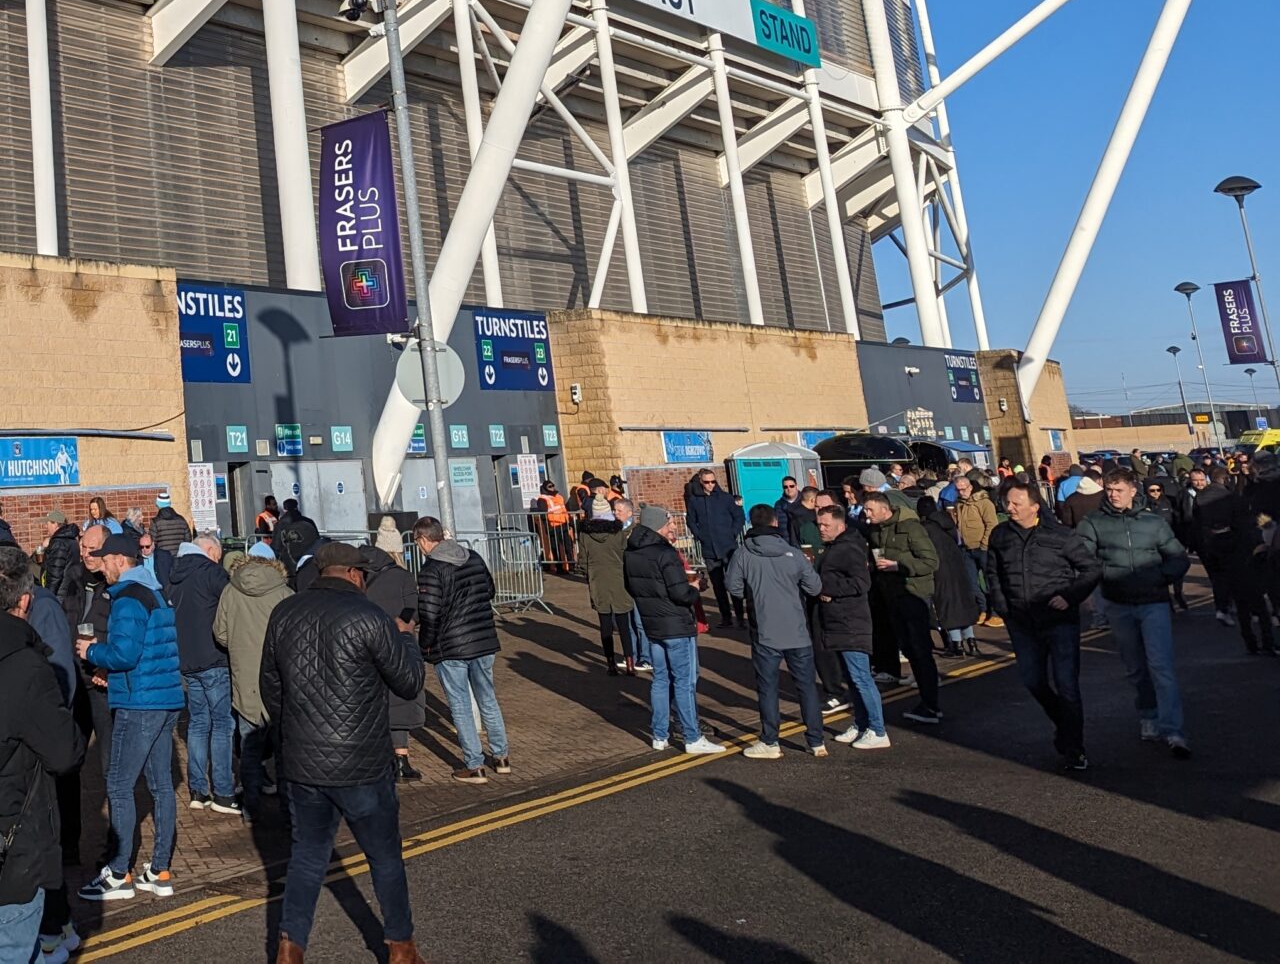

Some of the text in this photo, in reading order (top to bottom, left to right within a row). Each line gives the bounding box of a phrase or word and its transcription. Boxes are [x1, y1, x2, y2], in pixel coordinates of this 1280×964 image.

[759, 8, 812, 56] STAND
[335, 139, 359, 252] FRASERS
[358, 187, 383, 250] PLUS
[176, 291, 244, 319] NSTILES
[1223, 289, 1242, 333] FRASERS
[475, 316, 547, 339] TURNSTILES
[1238, 308, 1253, 333] PLUS
[227, 330, 236, 342] 21
[483, 346, 492, 356] 22
[536, 348, 544, 358] 23
[944, 354, 977, 370] TURNSTILES
[229, 432, 248, 446] T21
[334, 432, 351, 445] G14
[452, 430, 468, 442] G13
[491, 430, 505, 442] T22
[544, 430, 558, 441] T23
